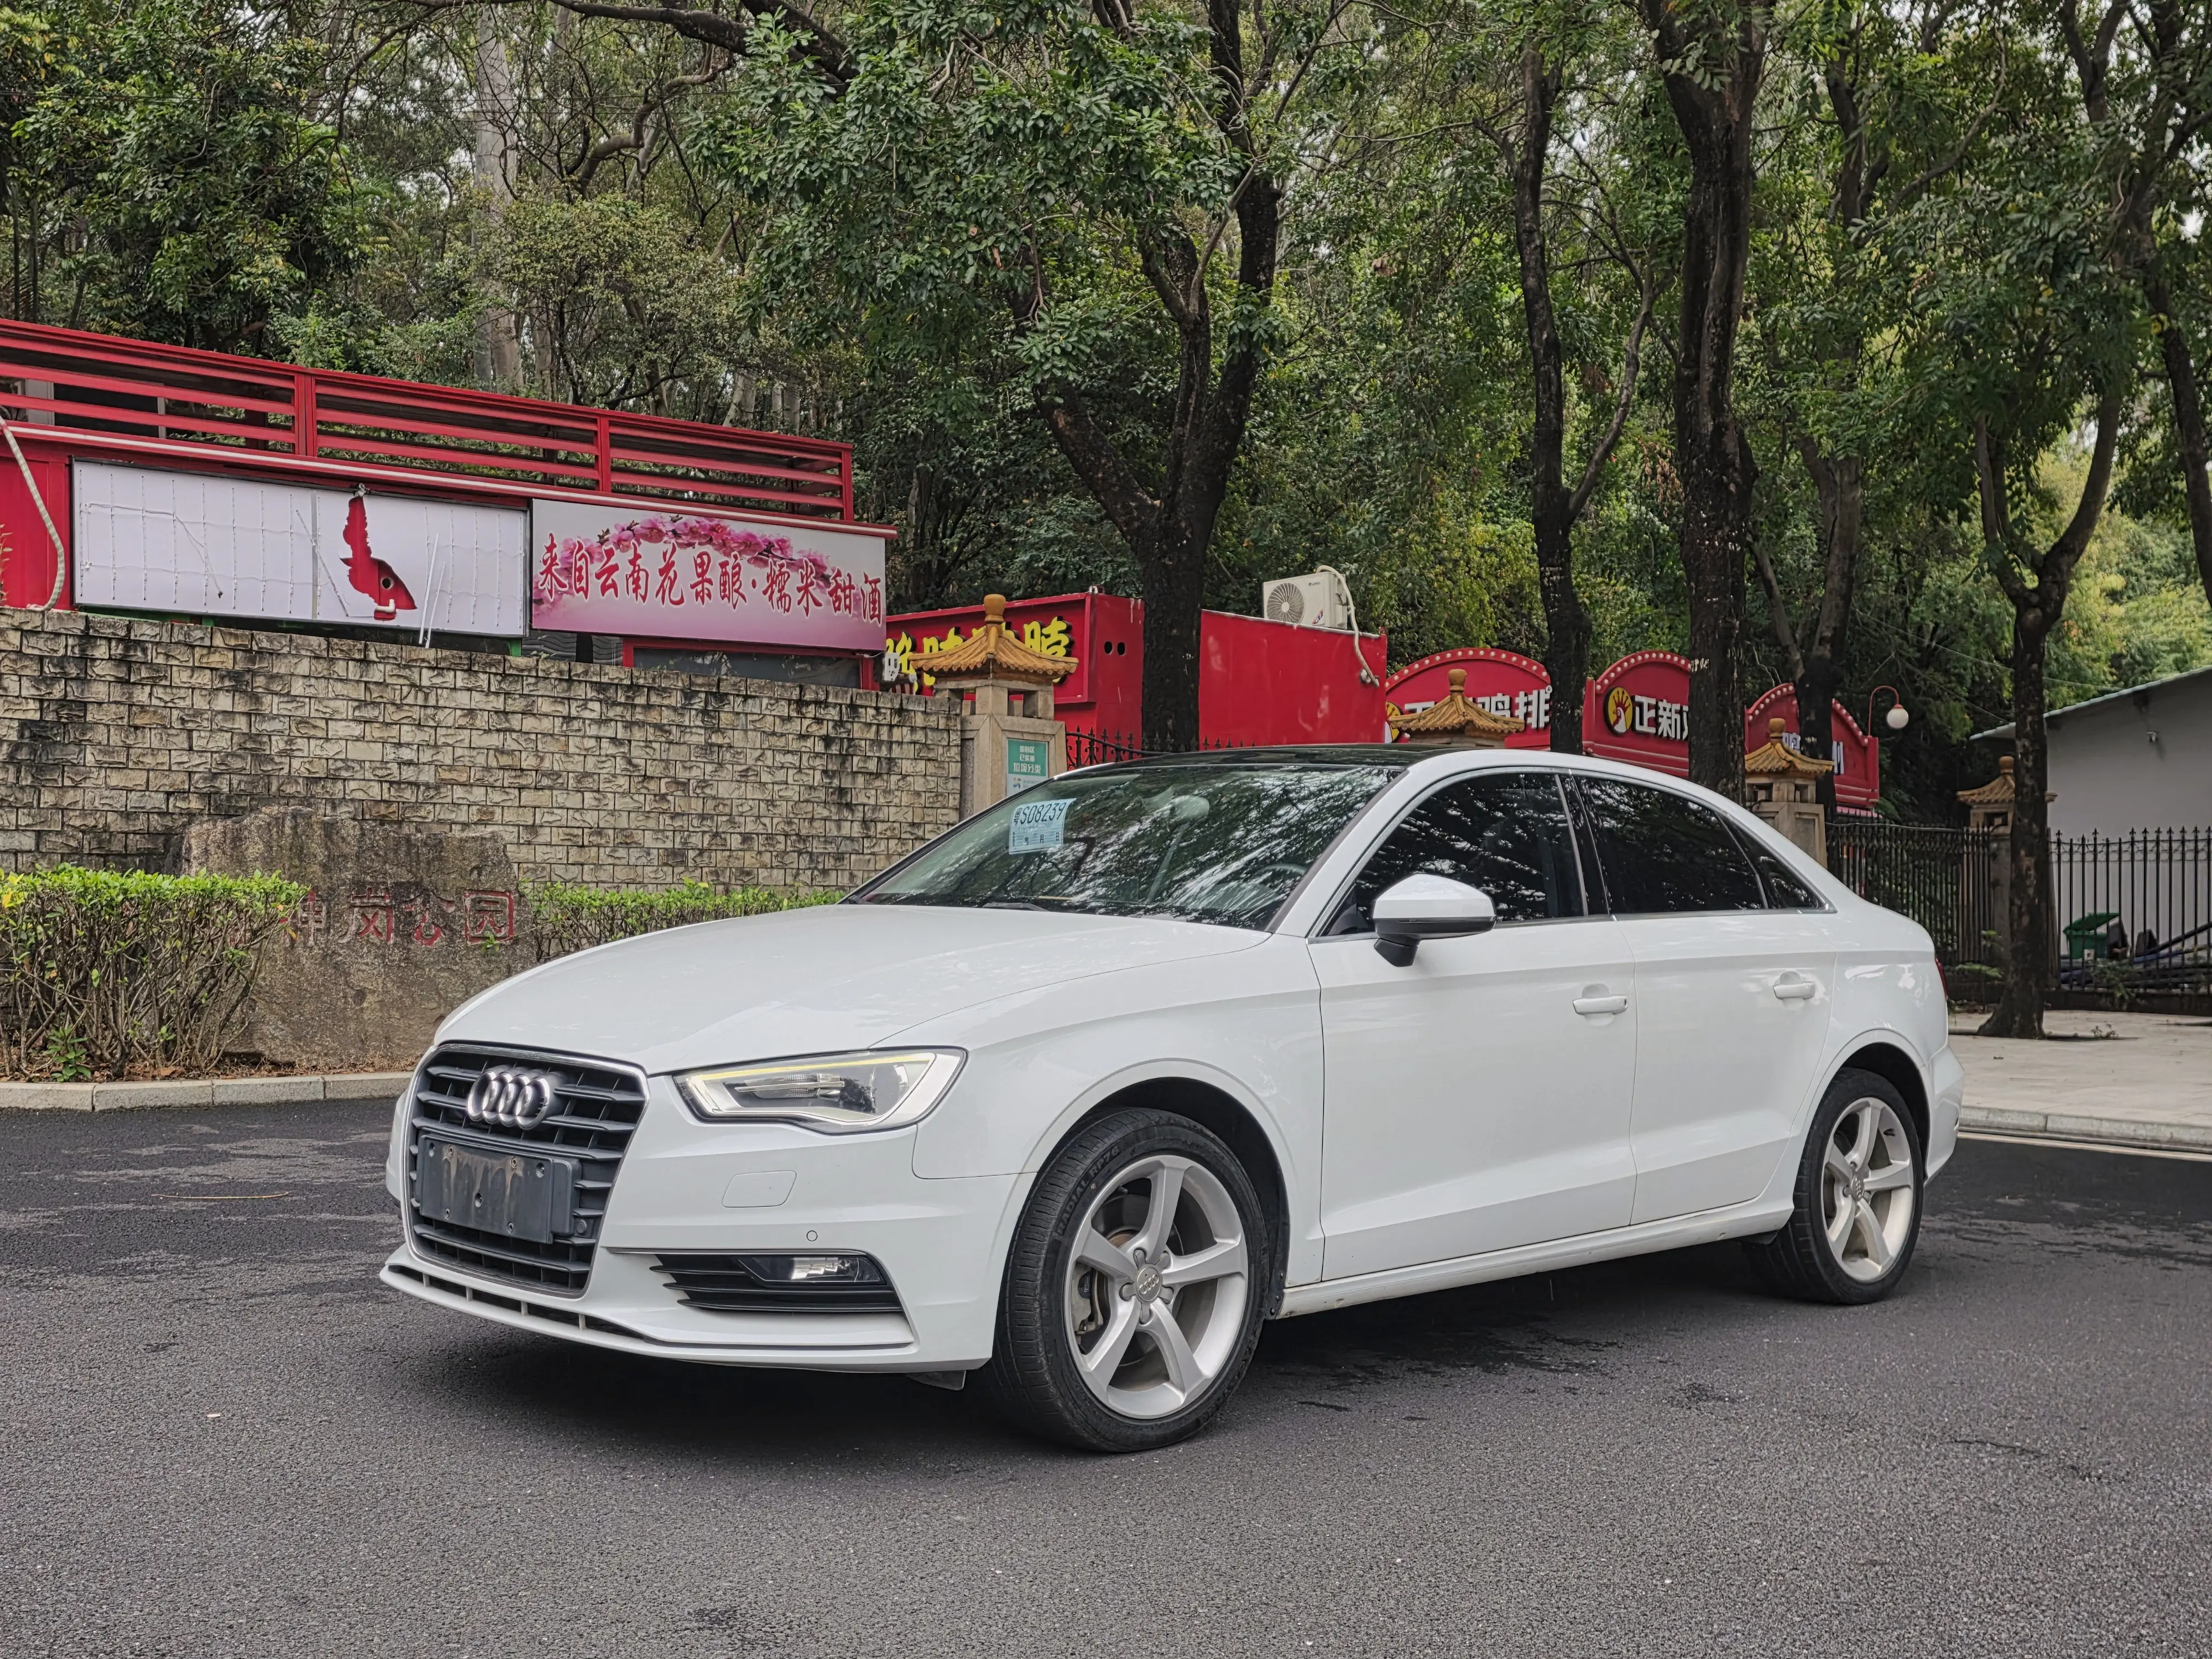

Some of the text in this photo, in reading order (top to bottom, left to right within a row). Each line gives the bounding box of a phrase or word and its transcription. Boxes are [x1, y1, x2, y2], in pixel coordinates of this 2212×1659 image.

[538, 532, 884, 625] 来自云南花果酿·糯米甜酒
[1635, 695, 1689, 740] 正新
[1014, 762, 1041, 774] 垃圾分类
[1057, 1180, 1089, 1235] RADIAL
